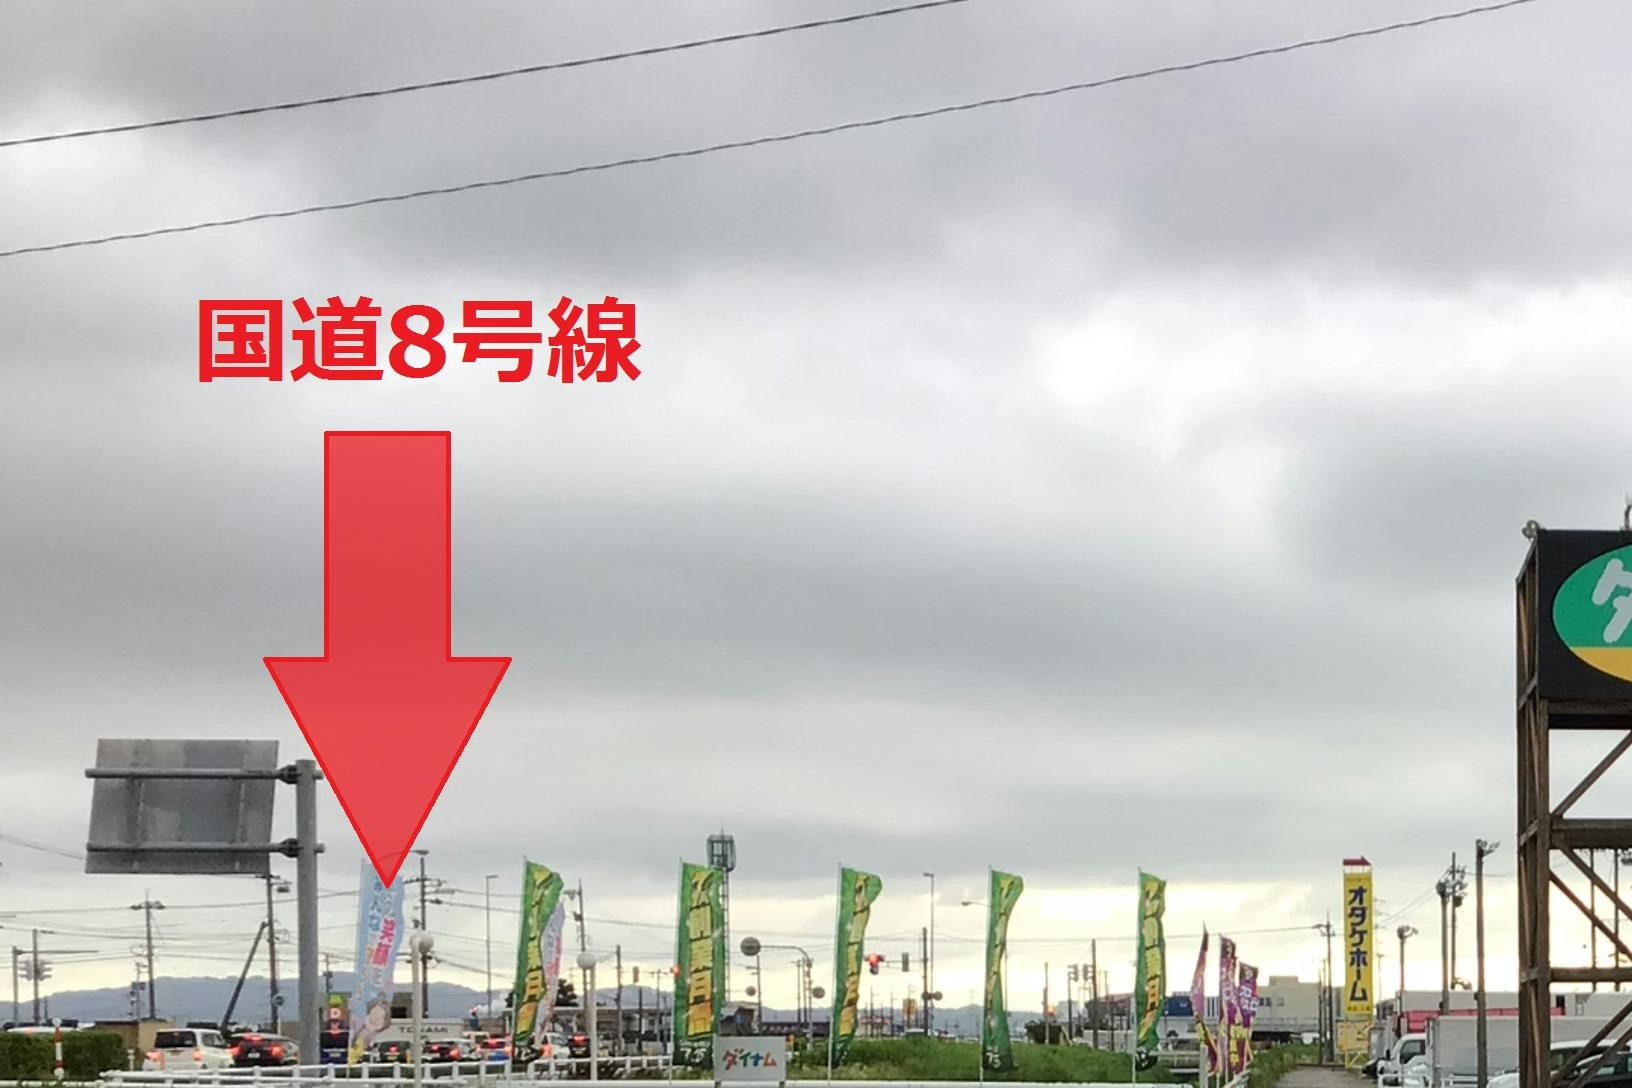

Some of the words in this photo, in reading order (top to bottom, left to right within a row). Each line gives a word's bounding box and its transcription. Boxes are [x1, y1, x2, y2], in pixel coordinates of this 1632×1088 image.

[1347, 885, 1368, 1002] オタケホーム
[722, 1048, 777, 1071] ダイナム
